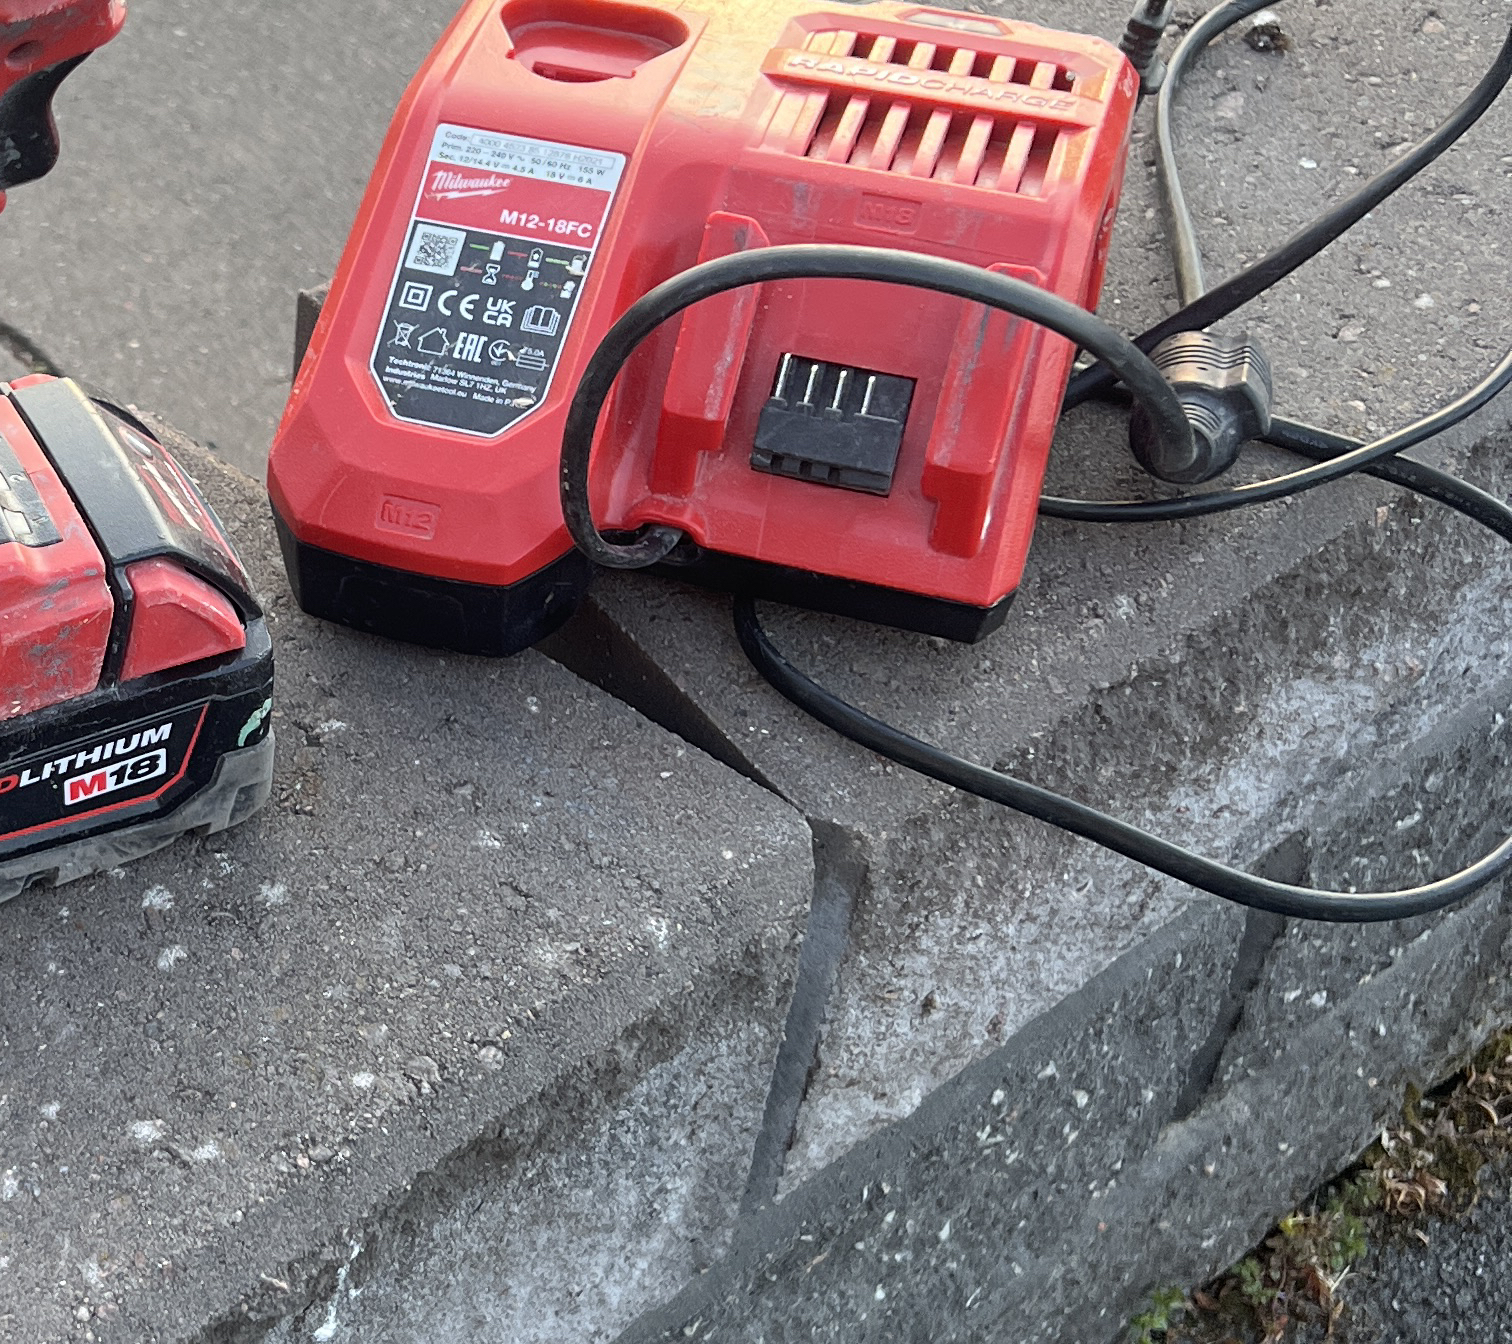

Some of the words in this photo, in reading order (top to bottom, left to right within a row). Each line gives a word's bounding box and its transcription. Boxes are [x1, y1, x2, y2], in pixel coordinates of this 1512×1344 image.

[787, 54, 1079, 111] RAPIDCHARGE
[465, 146, 482, 155] 220
[432, 169, 512, 192] Milwaukee
[499, 209, 593, 238] M12-18FC
[437, 289, 480, 321] CE
[385, 365, 426, 380] Industries
[379, 500, 434, 531] M12
[69, 753, 164, 802] M18
